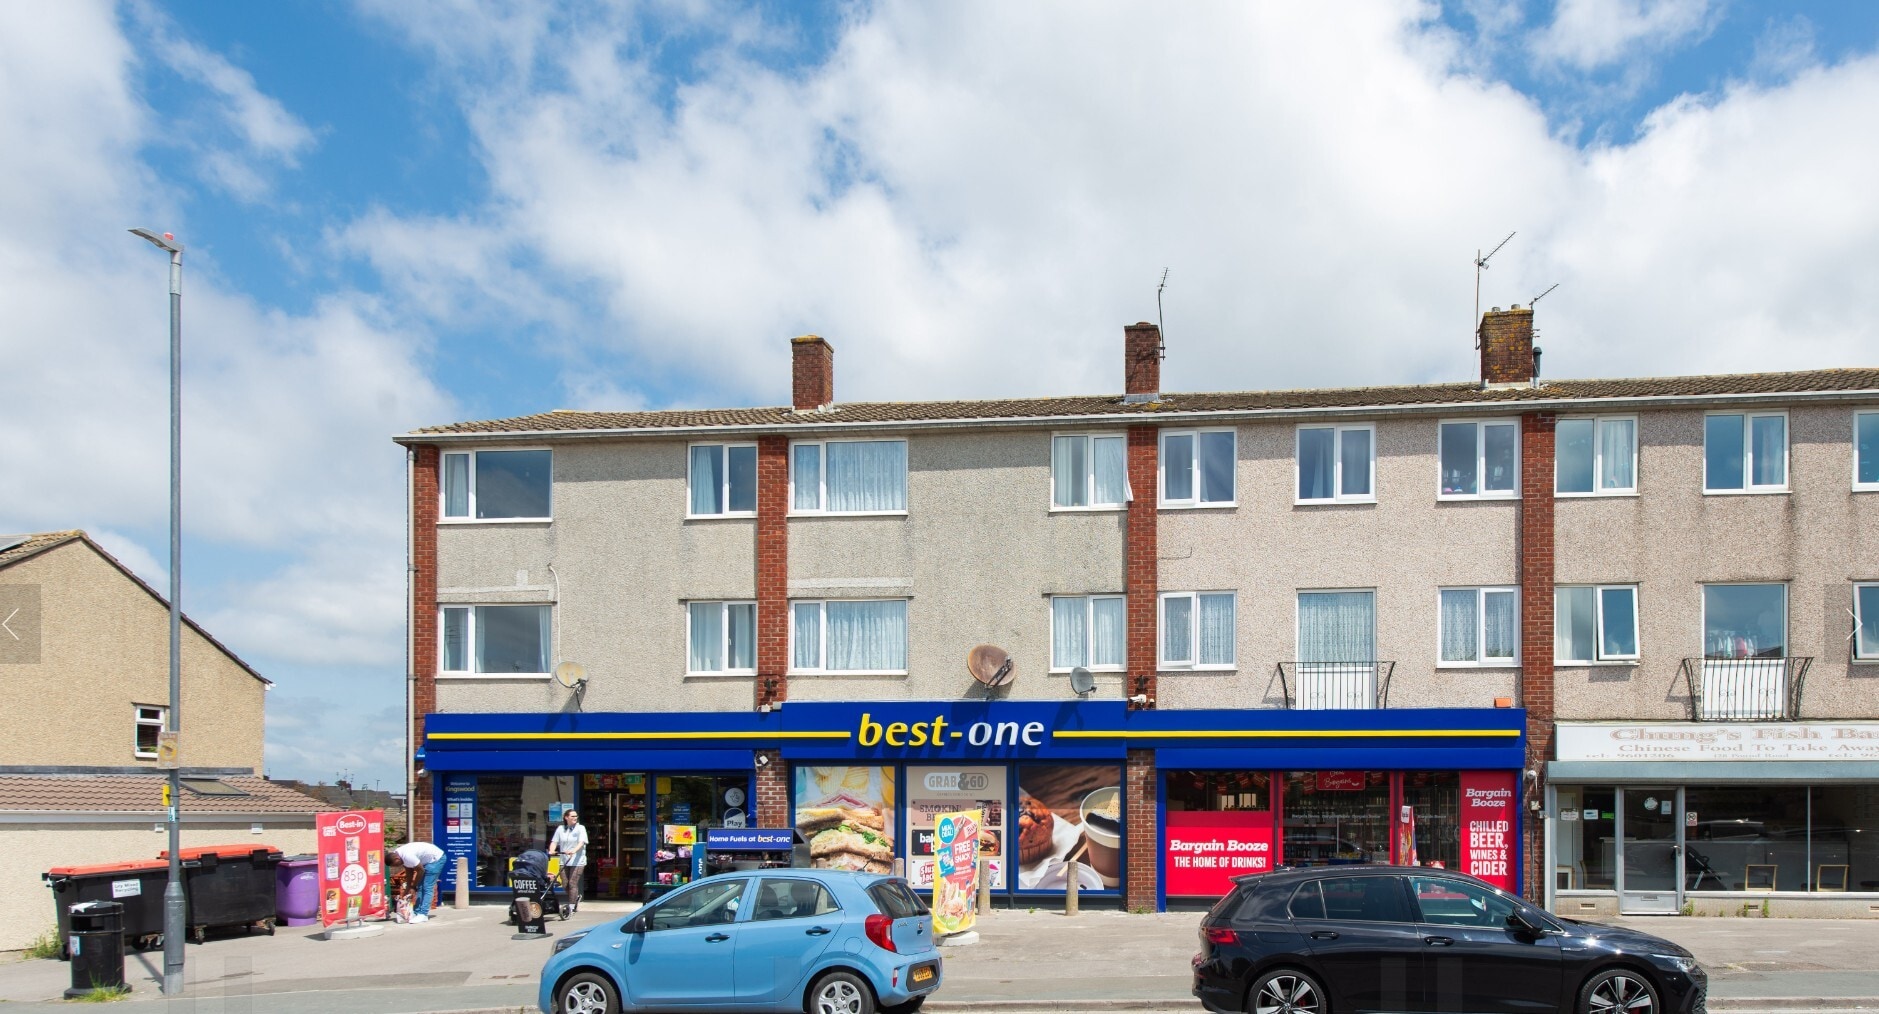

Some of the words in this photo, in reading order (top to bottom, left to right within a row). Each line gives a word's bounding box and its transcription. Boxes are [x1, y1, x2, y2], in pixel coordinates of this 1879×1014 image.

[858, 713, 1045, 746] best-one
[1610, 728, 1742, 744] Chung's
[1752, 727, 1822, 740] Fish
[1619, 744, 1690, 752] Chinese
[1465, 788, 1512, 799] Bargain
[1471, 798, 1506, 807] Booze
[919, 804, 962, 813] SMOKIN'
[339, 820, 364, 829] Best-in
[727, 820, 743, 828] Play
[1469, 820, 1509, 832] CHILLED
[757, 835, 791, 843] best-one
[1470, 832, 1508, 849] BEER,
[954, 840, 971, 855] FREE
[1169, 839, 1225, 854] Bargain
[1227, 839, 1269, 851] Booze
[1470, 849, 1498, 860] WINES
[1500, 849, 1507, 860] &
[1174, 856, 1191, 868] THE
[1192, 856, 1217, 868] HOME
[1219, 856, 1229, 868] OF
[1232, 856, 1267, 868] DRINKS!
[1470, 861, 1508, 876] CIDER
[344, 869, 364, 883] 85p
[513, 879, 538, 890] COFFEE
